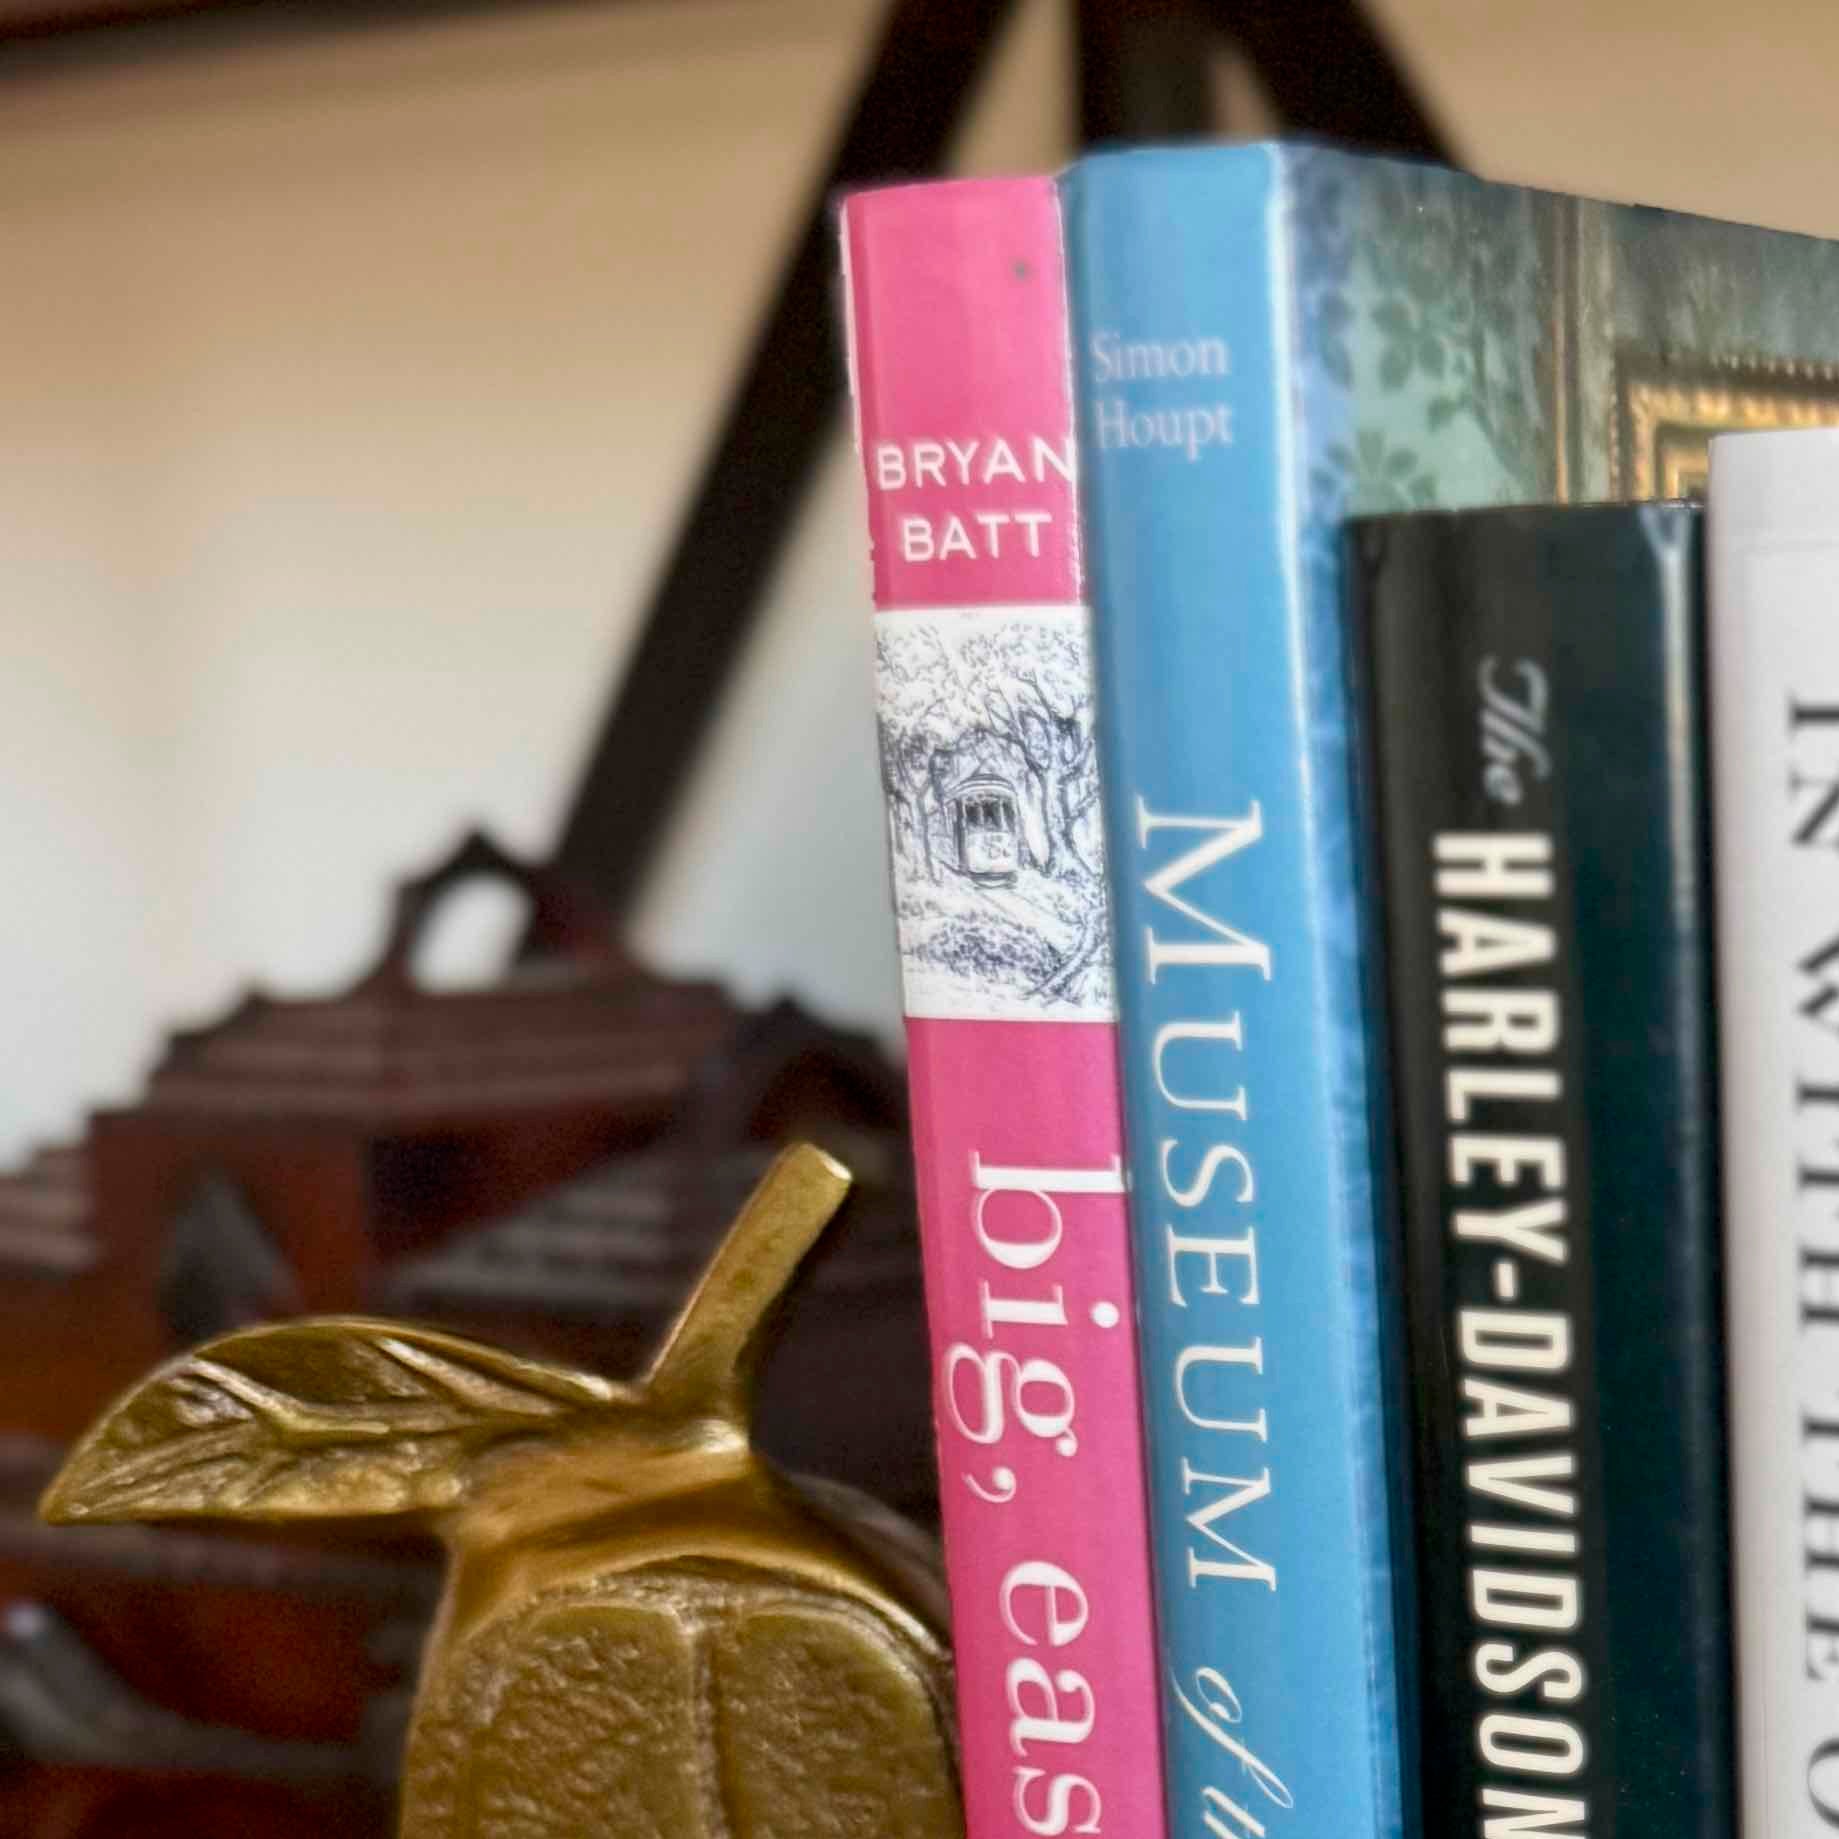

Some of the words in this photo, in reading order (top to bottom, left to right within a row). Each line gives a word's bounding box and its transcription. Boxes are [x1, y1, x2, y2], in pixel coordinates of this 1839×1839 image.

[1090, 333, 1231, 382] Simon
[876, 436, 1074, 491] BRYAN
[1096, 402, 1234, 461] Houpt
[903, 512, 1051, 562] BATT
[1479, 655, 1551, 804] The
[1136, 795, 1278, 1592] MUSEUM
[944, 1150, 1128, 1503] big,
[1169, 1664, 1294, 1809] of
